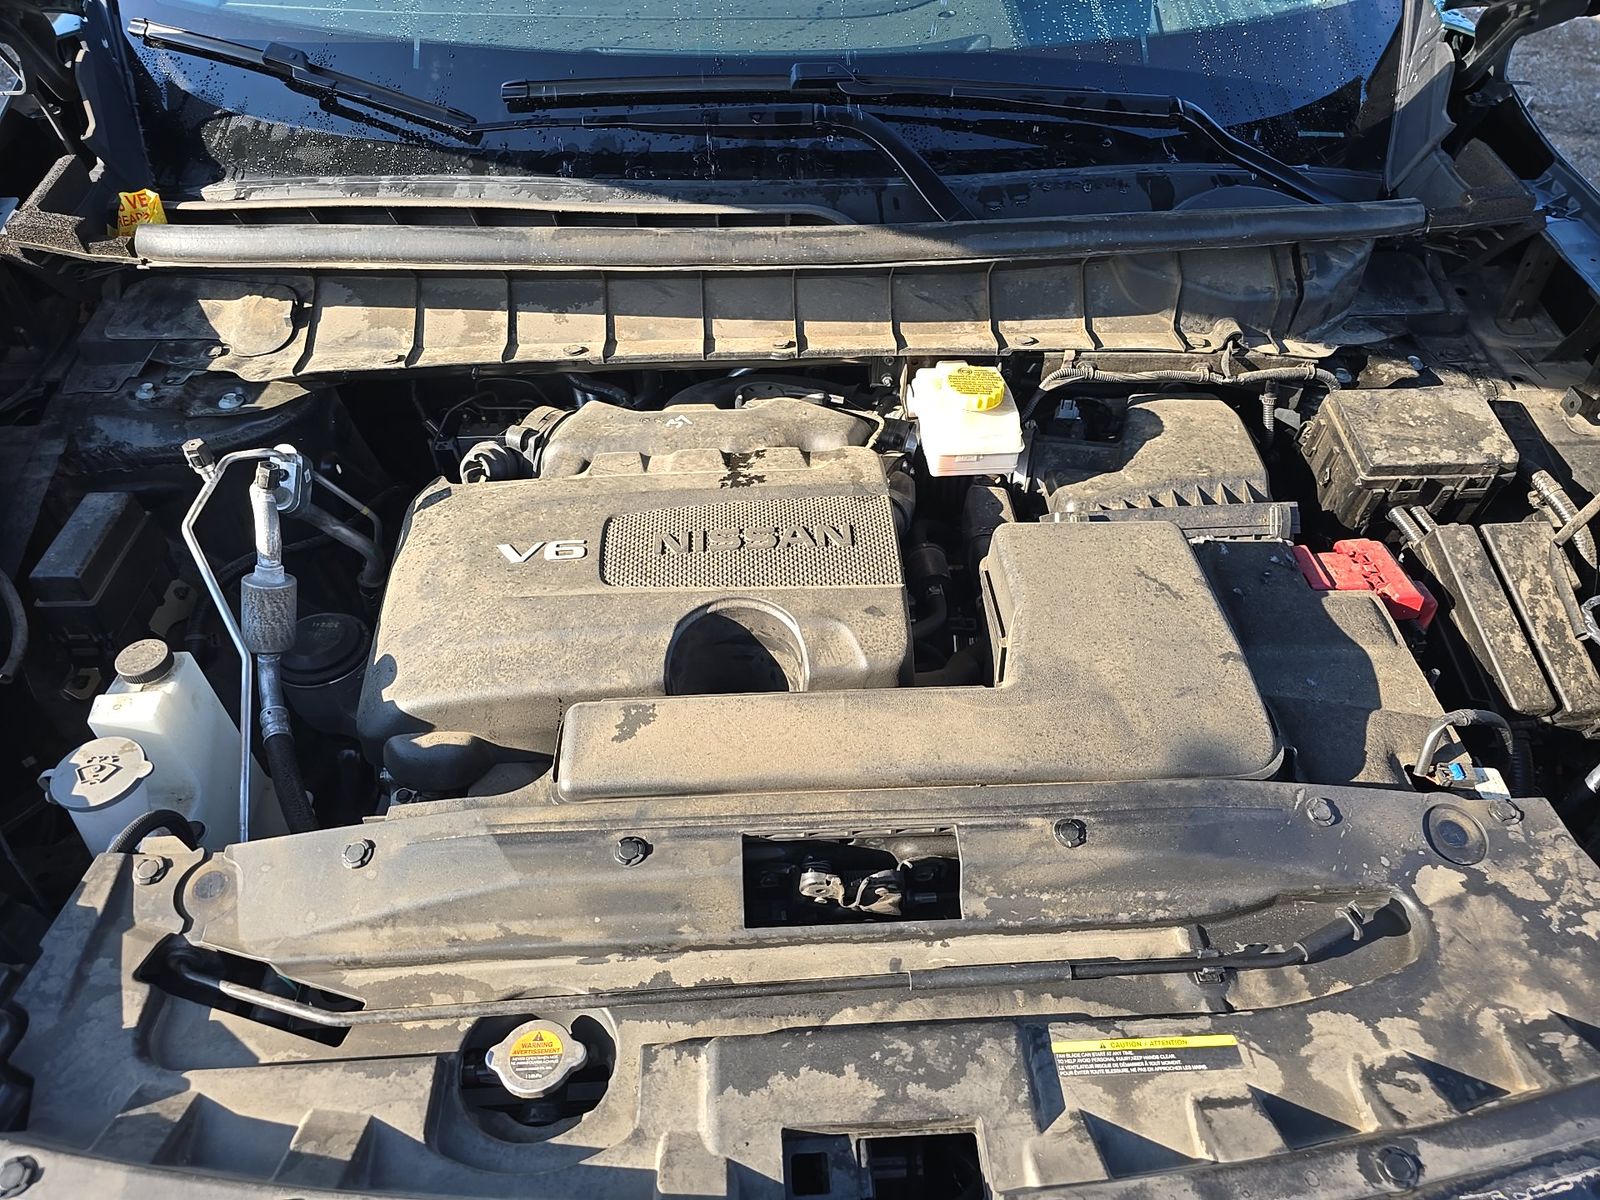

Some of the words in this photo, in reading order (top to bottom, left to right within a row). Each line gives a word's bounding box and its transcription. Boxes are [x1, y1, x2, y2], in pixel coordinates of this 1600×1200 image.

[653, 523, 854, 555] NISSAN
[497, 539, 588, 564] V6
[521, 1041, 553, 1049] WARNING
[1149, 1039, 1188, 1047] ATTENTION
